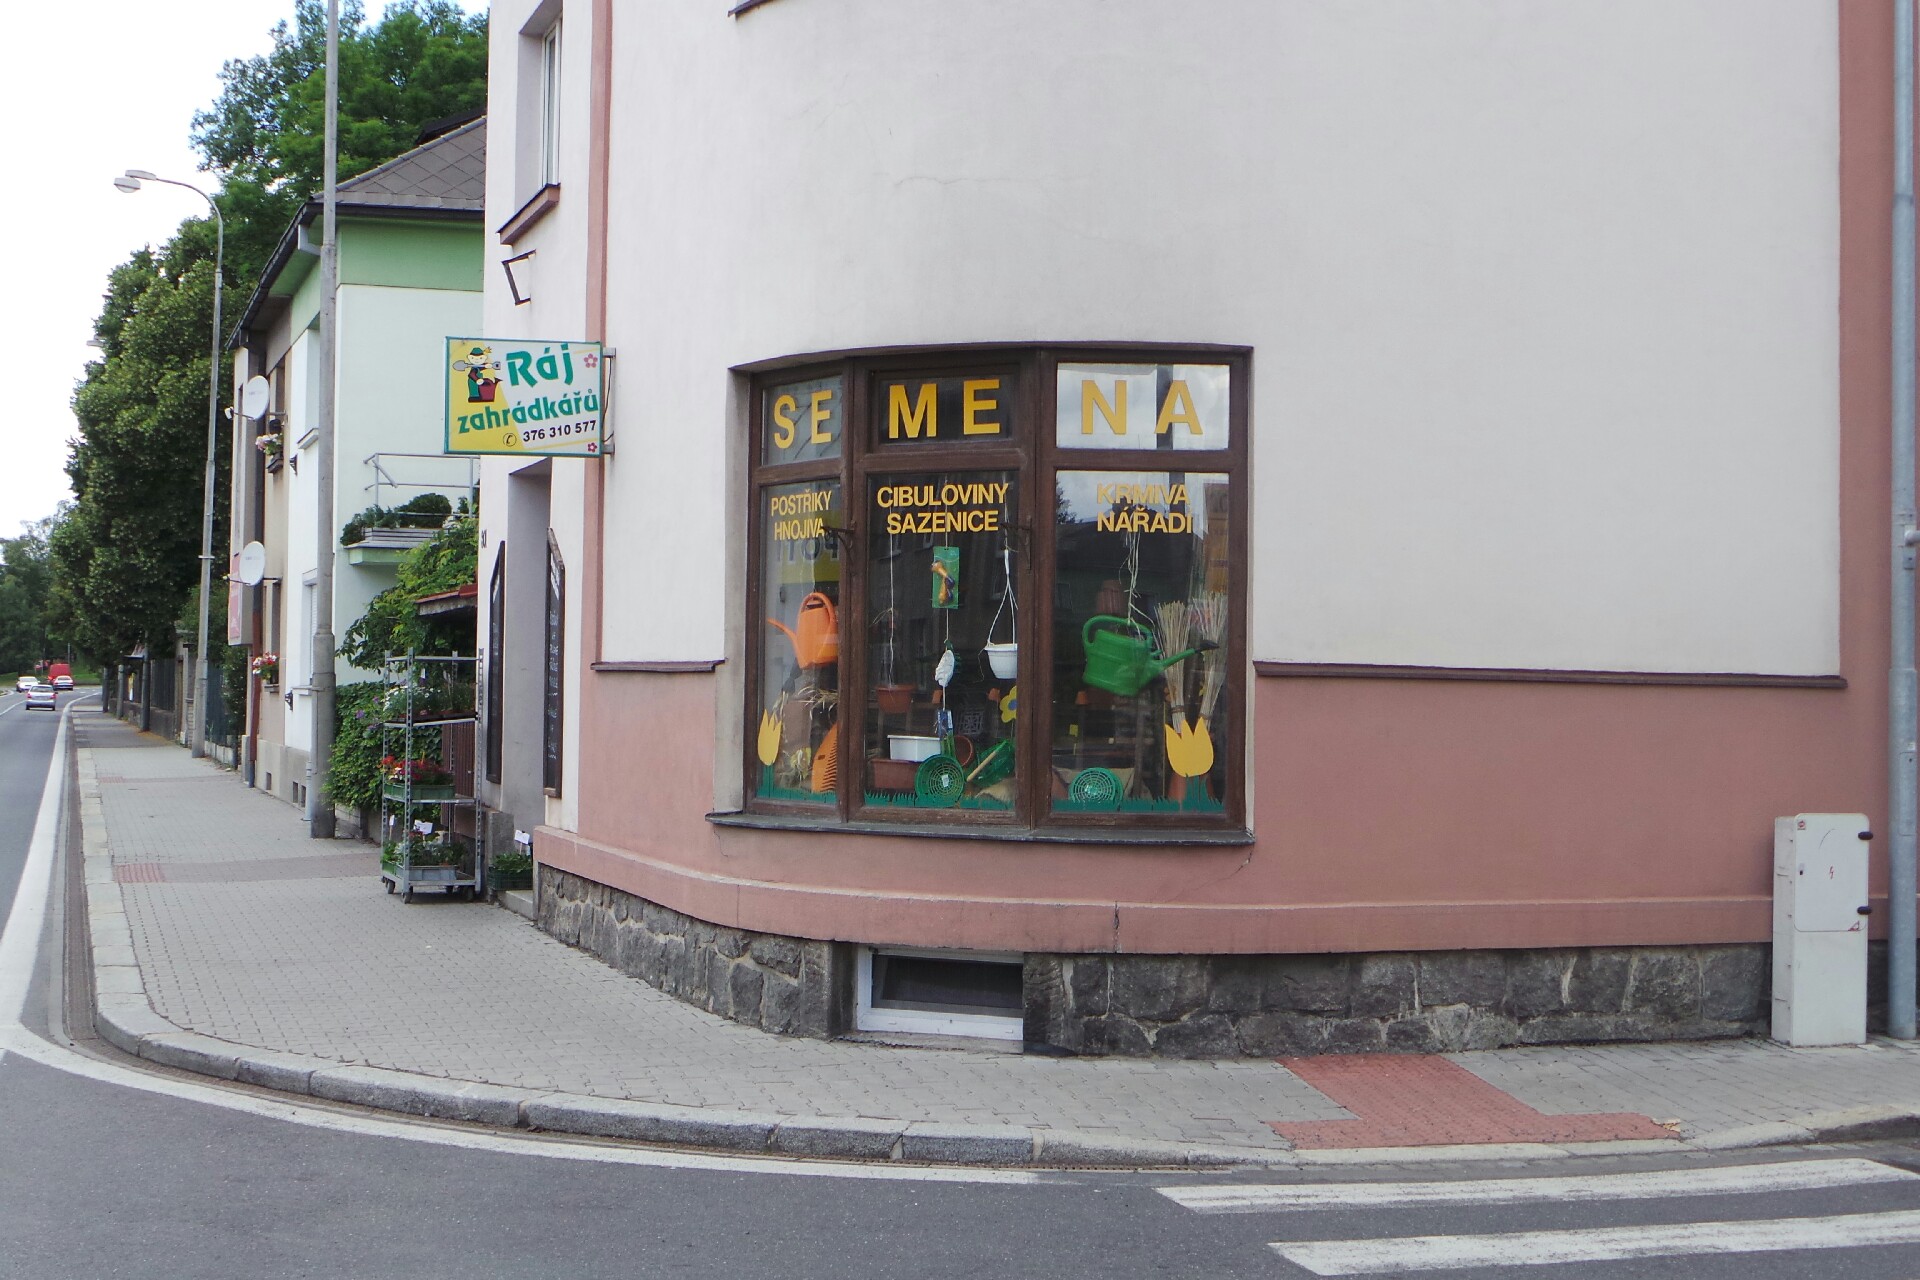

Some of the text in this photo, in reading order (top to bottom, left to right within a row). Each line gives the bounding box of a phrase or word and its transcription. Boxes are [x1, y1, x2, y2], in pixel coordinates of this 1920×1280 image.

[506, 343, 574, 388] Ráj
[457, 389, 599, 434] zahrádkářů
[523, 420, 597, 442] 376 310 577
[771, 489, 832, 517] POSTŘIKY
[877, 482, 1009, 508] CIBULOVINY
[1097, 483, 1191, 504] KRMIVA
[774, 517, 825, 541] HNOJIVA
[886, 510, 999, 535] SAZENICE
[1097, 505, 1194, 533] NÁŘADÍ
